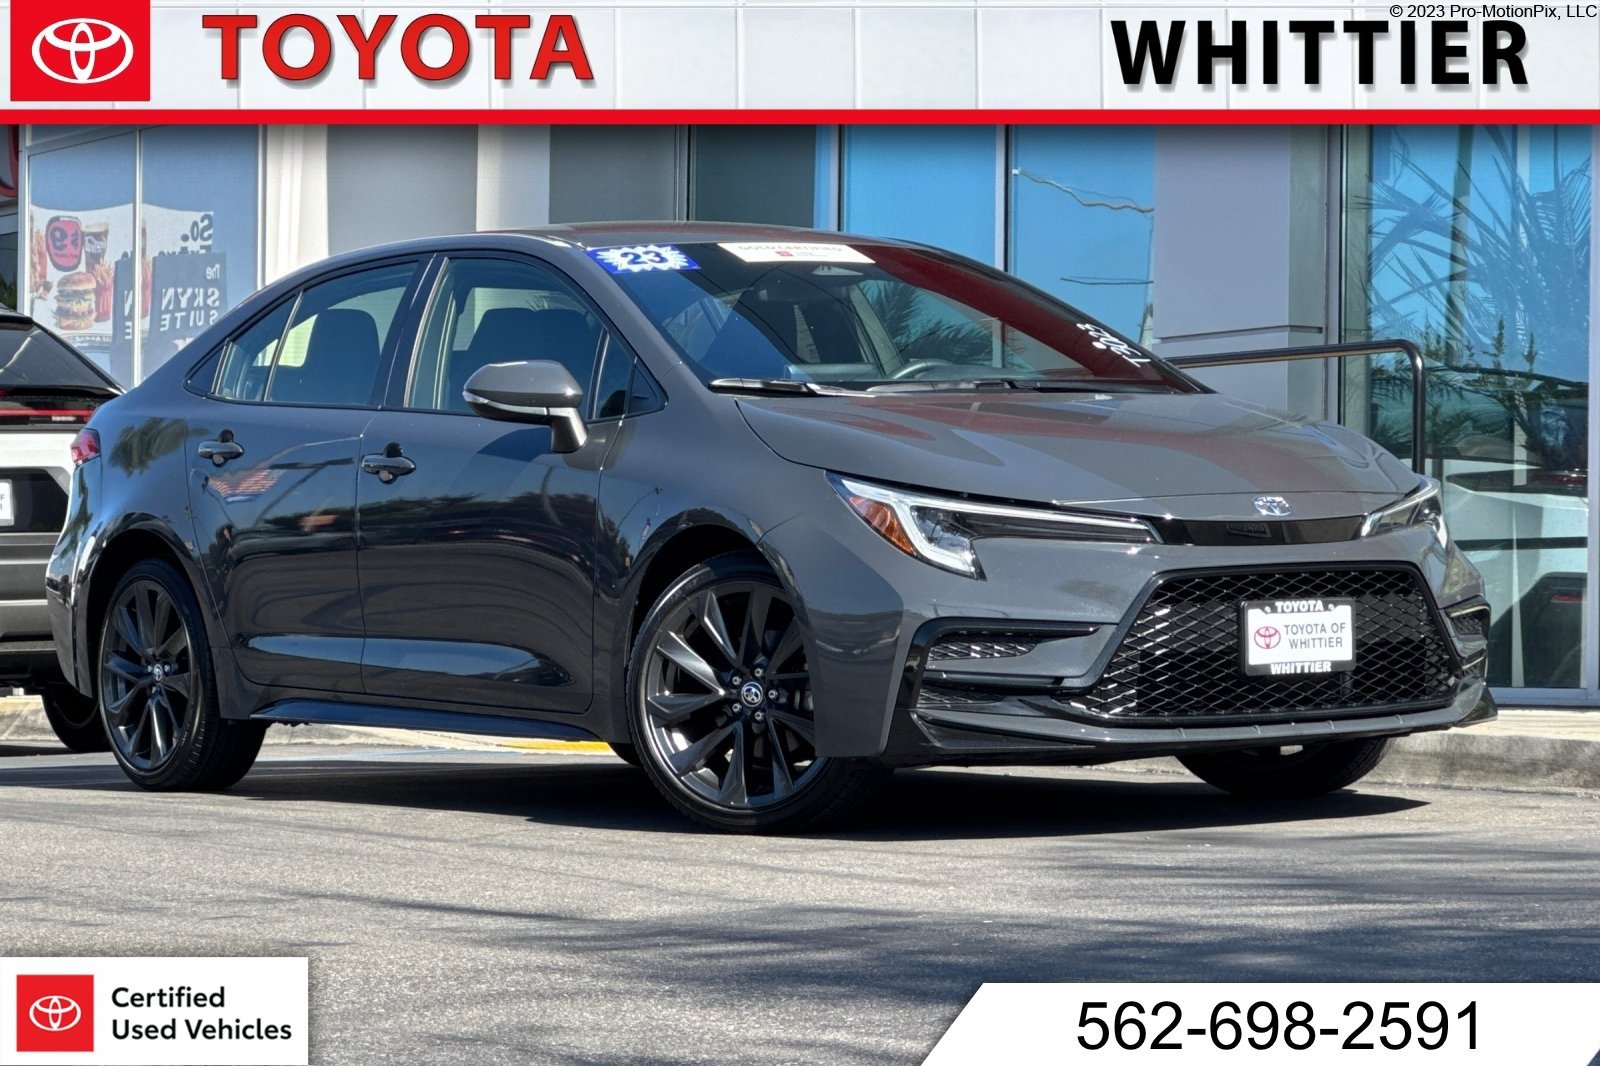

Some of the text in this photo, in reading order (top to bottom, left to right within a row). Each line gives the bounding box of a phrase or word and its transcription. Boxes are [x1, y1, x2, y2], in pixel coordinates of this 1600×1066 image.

[620, 250, 668, 266] 23
[1275, 600, 1324, 613] TOYOTA
[1284, 622, 1346, 636] TOYOTA OF
[1289, 637, 1343, 649] WHITTIER
[1270, 661, 1332, 675] WHITTIER
